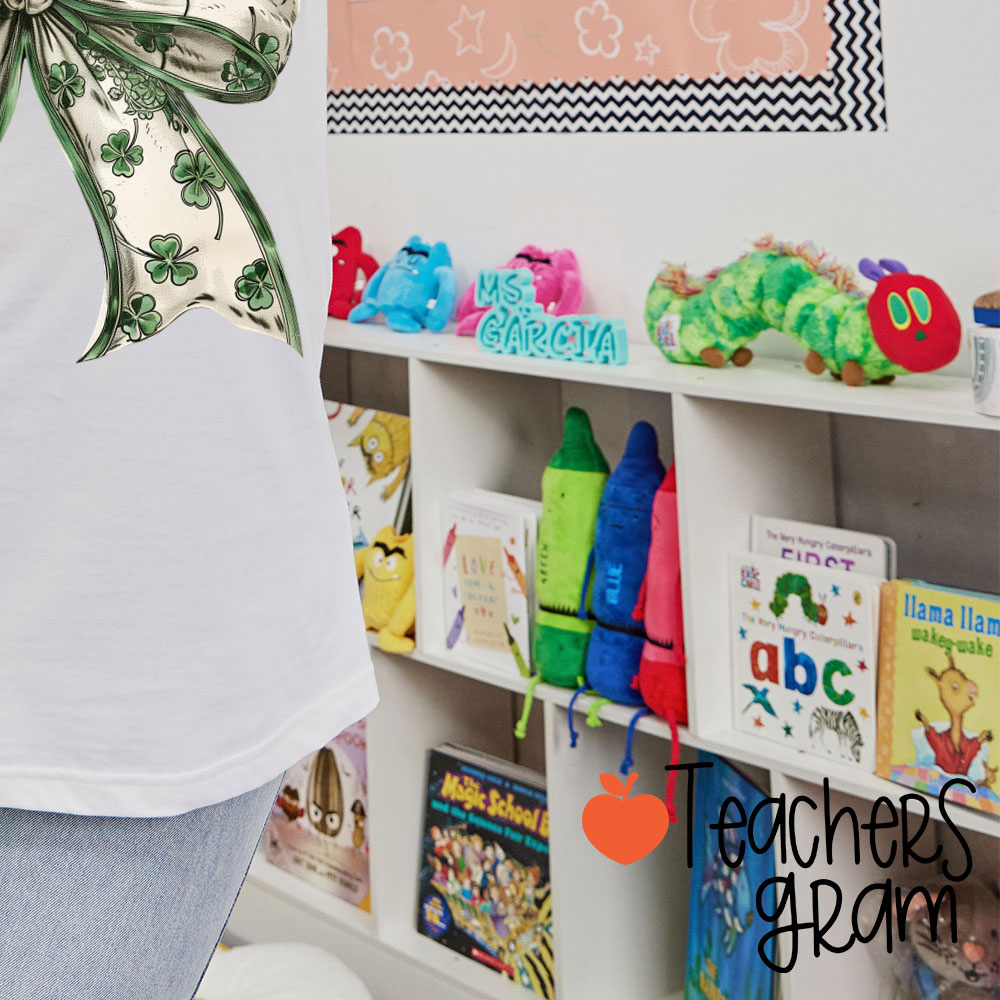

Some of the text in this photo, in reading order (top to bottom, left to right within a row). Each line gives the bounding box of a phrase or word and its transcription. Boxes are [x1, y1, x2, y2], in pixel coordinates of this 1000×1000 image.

[476, 308, 628, 366] GARCIA
[765, 528, 778, 540] The
[798, 536, 824, 549] Hungry
[904, 593, 954, 628] llama
[751, 637, 855, 706] abc
[441, 771, 486, 811] Magic
[487, 789, 541, 833] School
